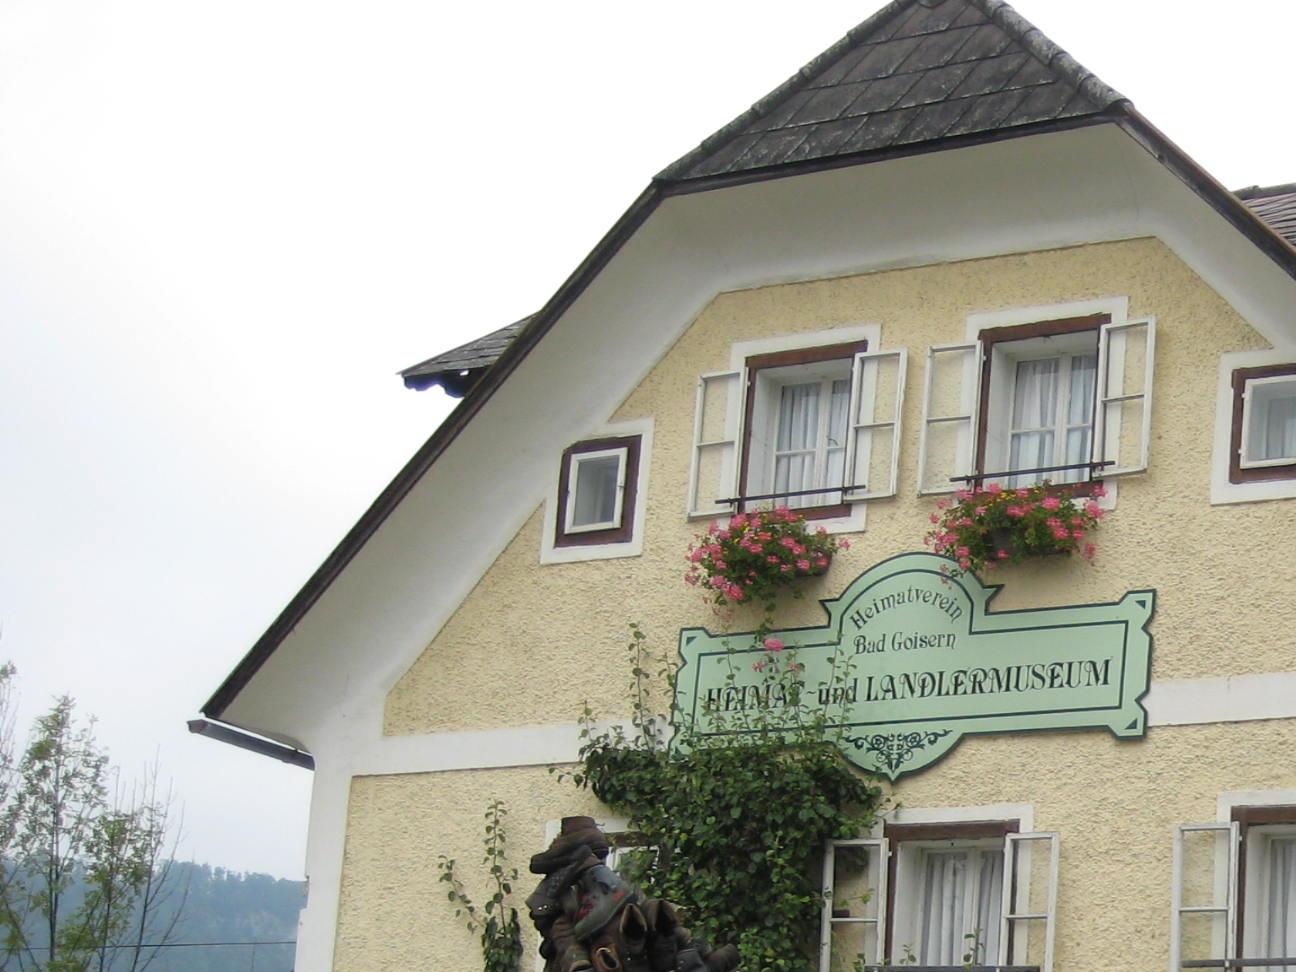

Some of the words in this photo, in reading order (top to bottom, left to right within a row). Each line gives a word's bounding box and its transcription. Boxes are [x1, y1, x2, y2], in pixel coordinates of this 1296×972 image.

[849, 585, 963, 630] Heimatverein
[854, 633, 886, 654] Bad
[891, 631, 956, 651] Goisern
[865, 657, 1113, 703] LANDLERMUSEUM
